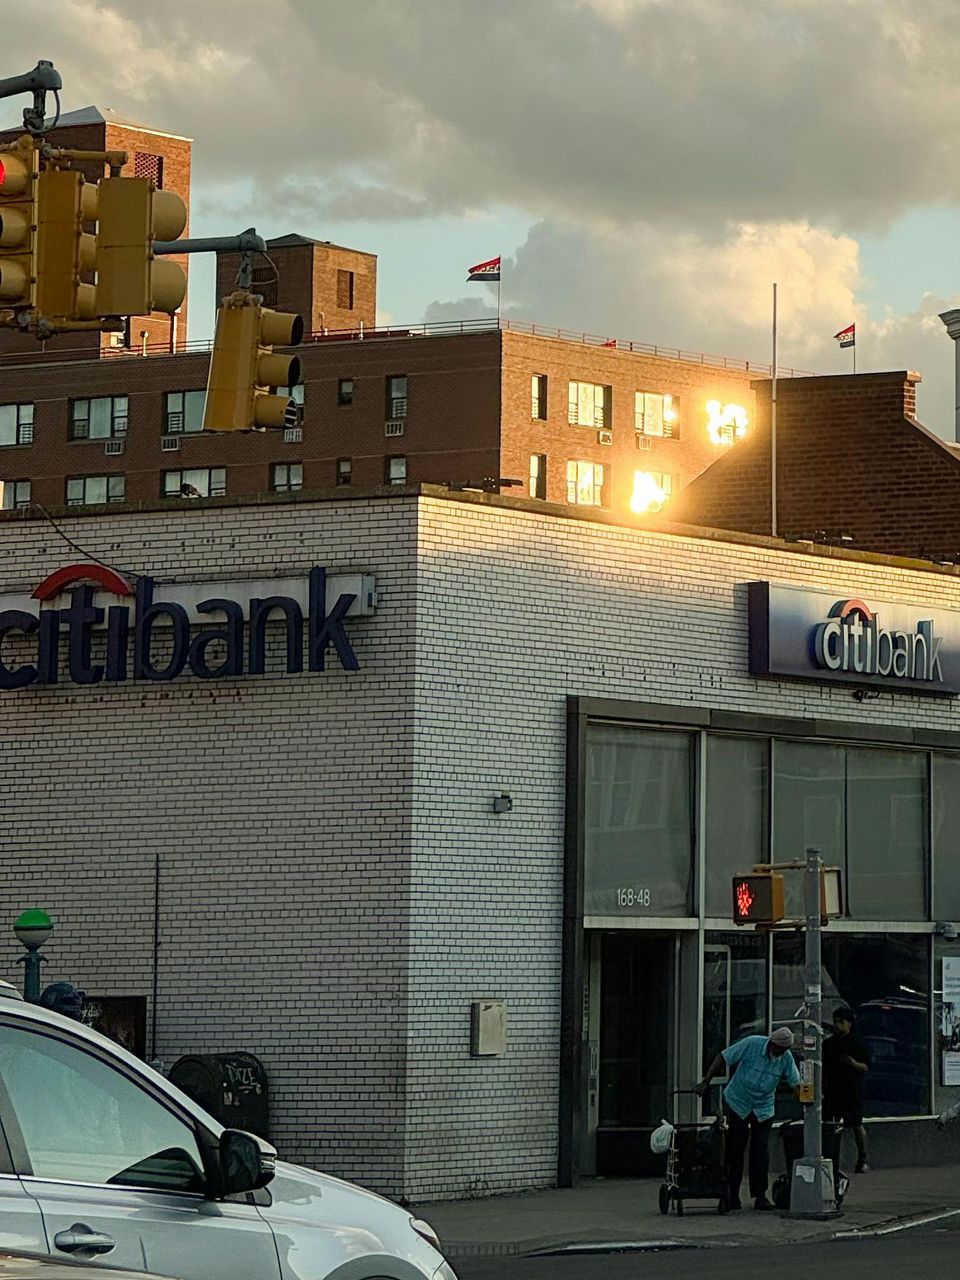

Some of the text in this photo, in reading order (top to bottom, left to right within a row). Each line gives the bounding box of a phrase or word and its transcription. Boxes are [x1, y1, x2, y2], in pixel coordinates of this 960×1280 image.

[0, 564, 361, 690] citibank
[817, 600, 943, 682] citibank
[617, 888, 651, 907] 168-48
